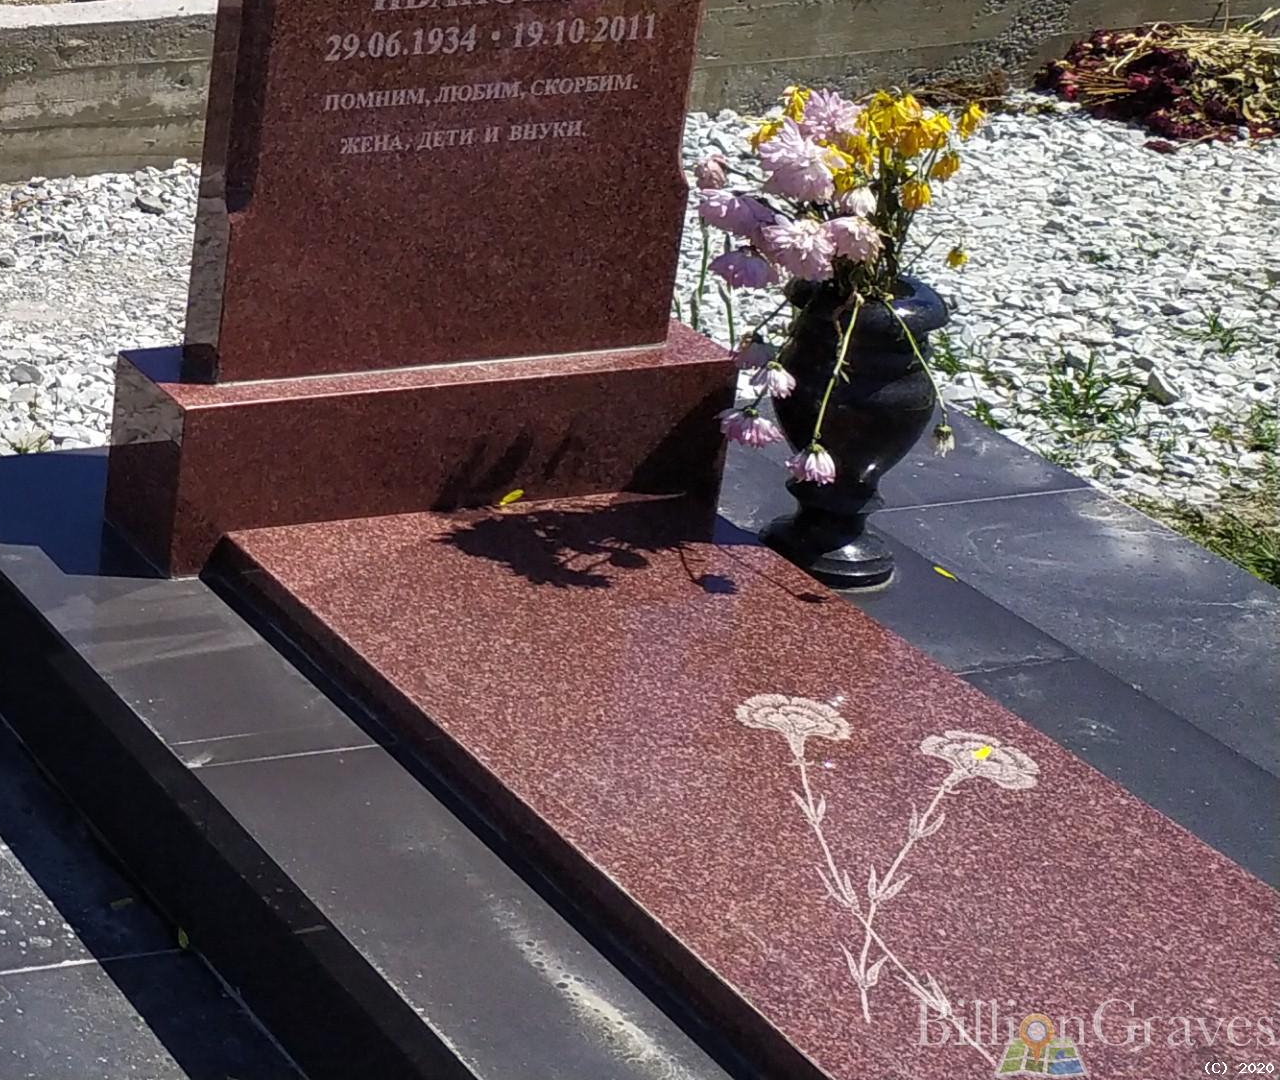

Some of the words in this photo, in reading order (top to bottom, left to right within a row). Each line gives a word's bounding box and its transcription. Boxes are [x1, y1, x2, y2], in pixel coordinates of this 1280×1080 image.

[324, 23, 478, 62] 29.06.1934
[512, 12, 658, 48] 19.10.2011
[322, 87, 431, 112] ПОМНИМ,
[434, 79, 526, 103] ЛЮБИМ,
[530, 73, 639, 96] СКОРБИМ.
[339, 133, 412, 155] ЖЕНА,
[416, 128, 476, 151] ДЕТИ
[484, 127, 500, 143] И
[509, 120, 587, 142] ВНУКИ.
